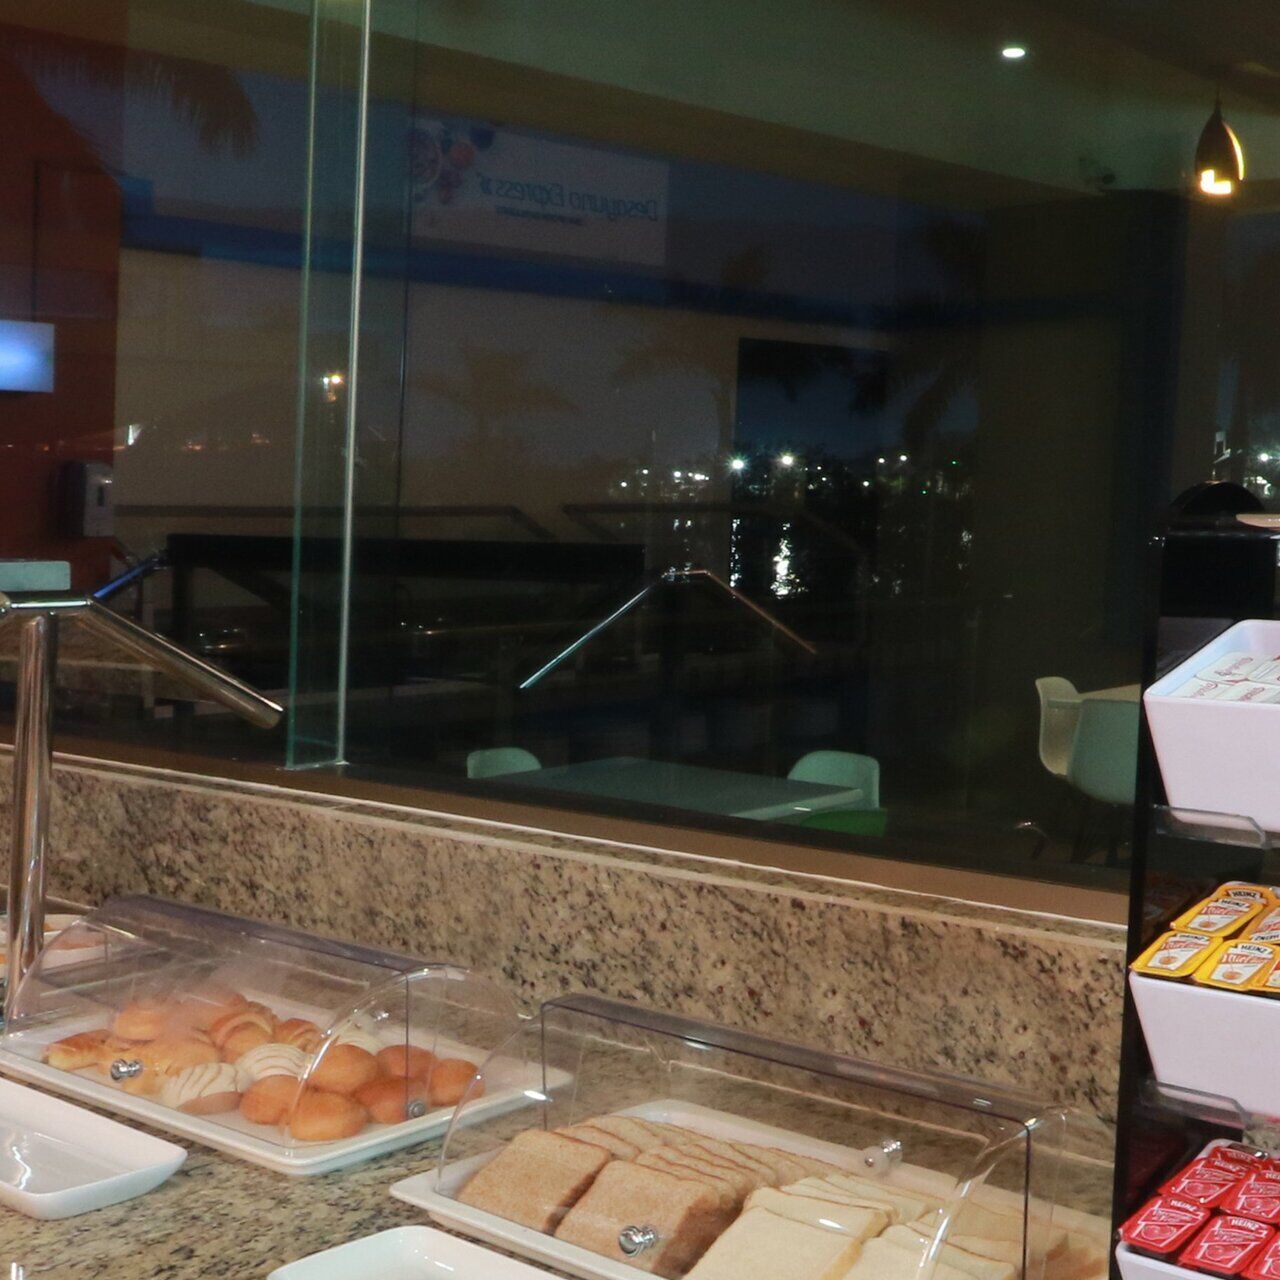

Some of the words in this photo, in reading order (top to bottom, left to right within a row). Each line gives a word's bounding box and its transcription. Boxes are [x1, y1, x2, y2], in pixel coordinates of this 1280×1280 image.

[1231, 890, 1257, 899] HEINZ
[1220, 899, 1245, 908] HEINZ
[1240, 944, 1268, 954] HEINZ
[1170, 1199, 1198, 1211] HEINZ
[1231, 1218, 1259, 1230] HEINZ
